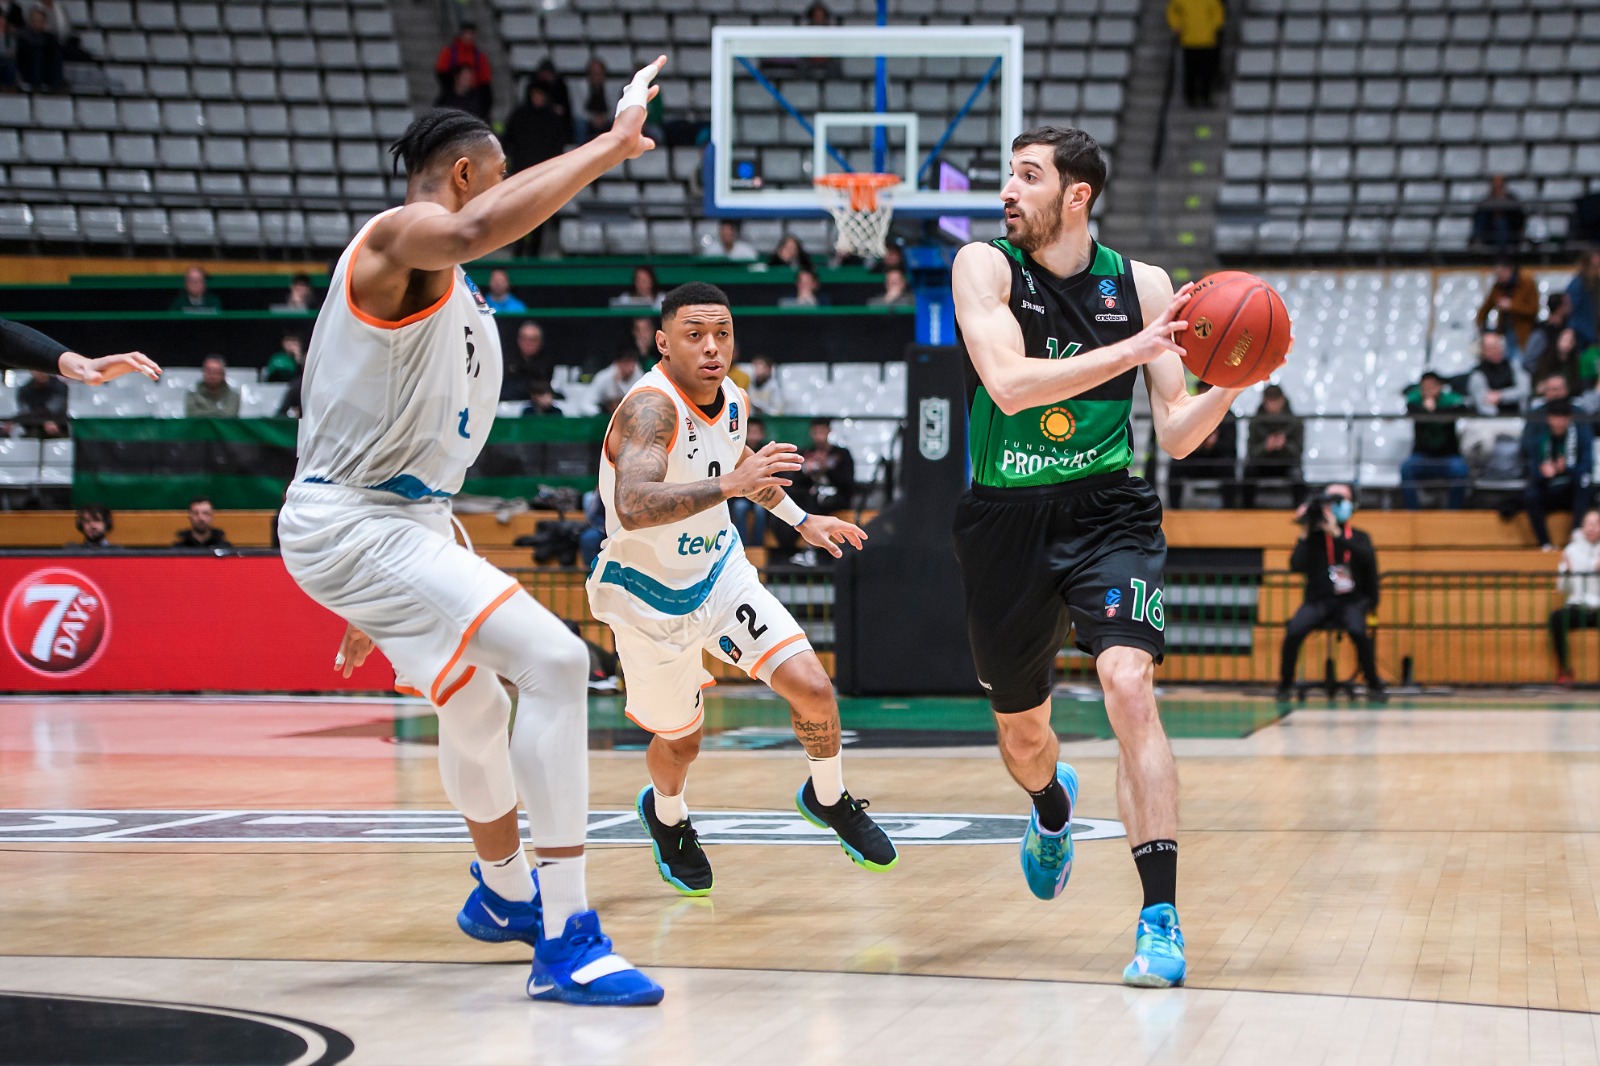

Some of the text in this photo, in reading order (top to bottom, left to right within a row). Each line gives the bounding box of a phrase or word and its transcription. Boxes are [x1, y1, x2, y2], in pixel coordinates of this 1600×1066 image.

[1020, 299, 1045, 315] SPADING
[1004, 439, 1079, 456] FUNDACI
[23, 583, 99, 663] 7 DAYS
[735, 603, 769, 641] 2
[1130, 577, 1165, 632] 16
